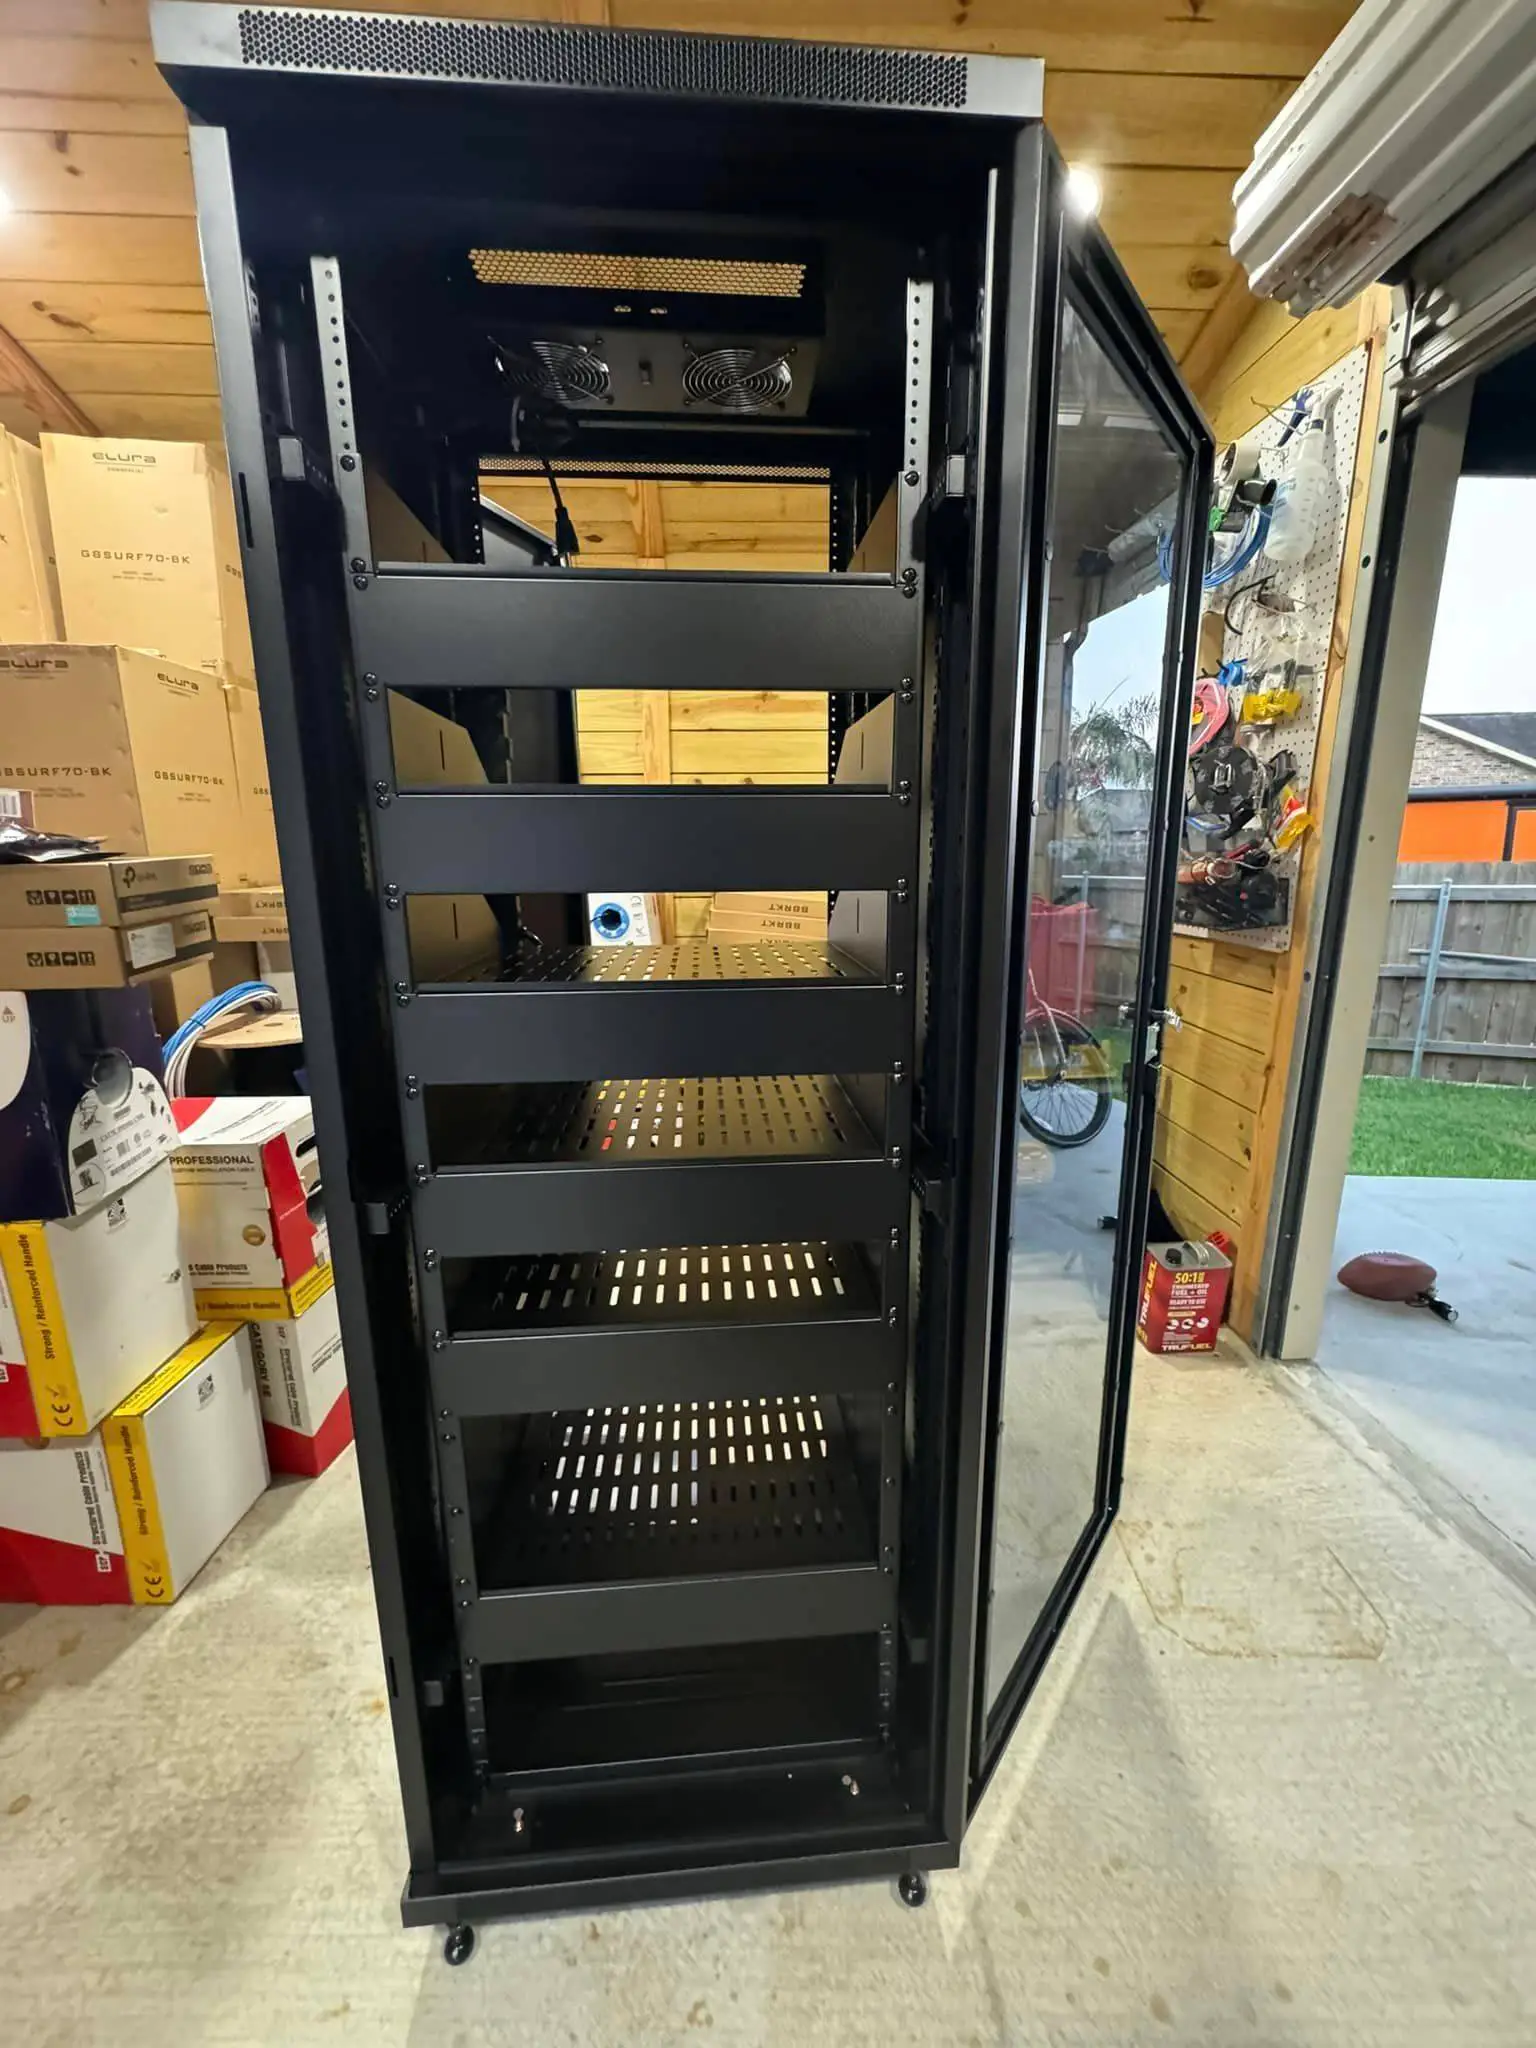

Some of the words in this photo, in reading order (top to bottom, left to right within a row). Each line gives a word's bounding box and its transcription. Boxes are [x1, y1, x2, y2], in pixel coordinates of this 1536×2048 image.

[0, 767, 112, 776] BSURF70-BK
[169, 1155, 254, 1164] PROFESSIONAL
[19, 1234, 34, 1268] Handle
[28, 1269, 45, 1320] Reinforced
[43, 1329, 56, 1359] Strong
[250, 1322, 268, 1382] CATEGORY
